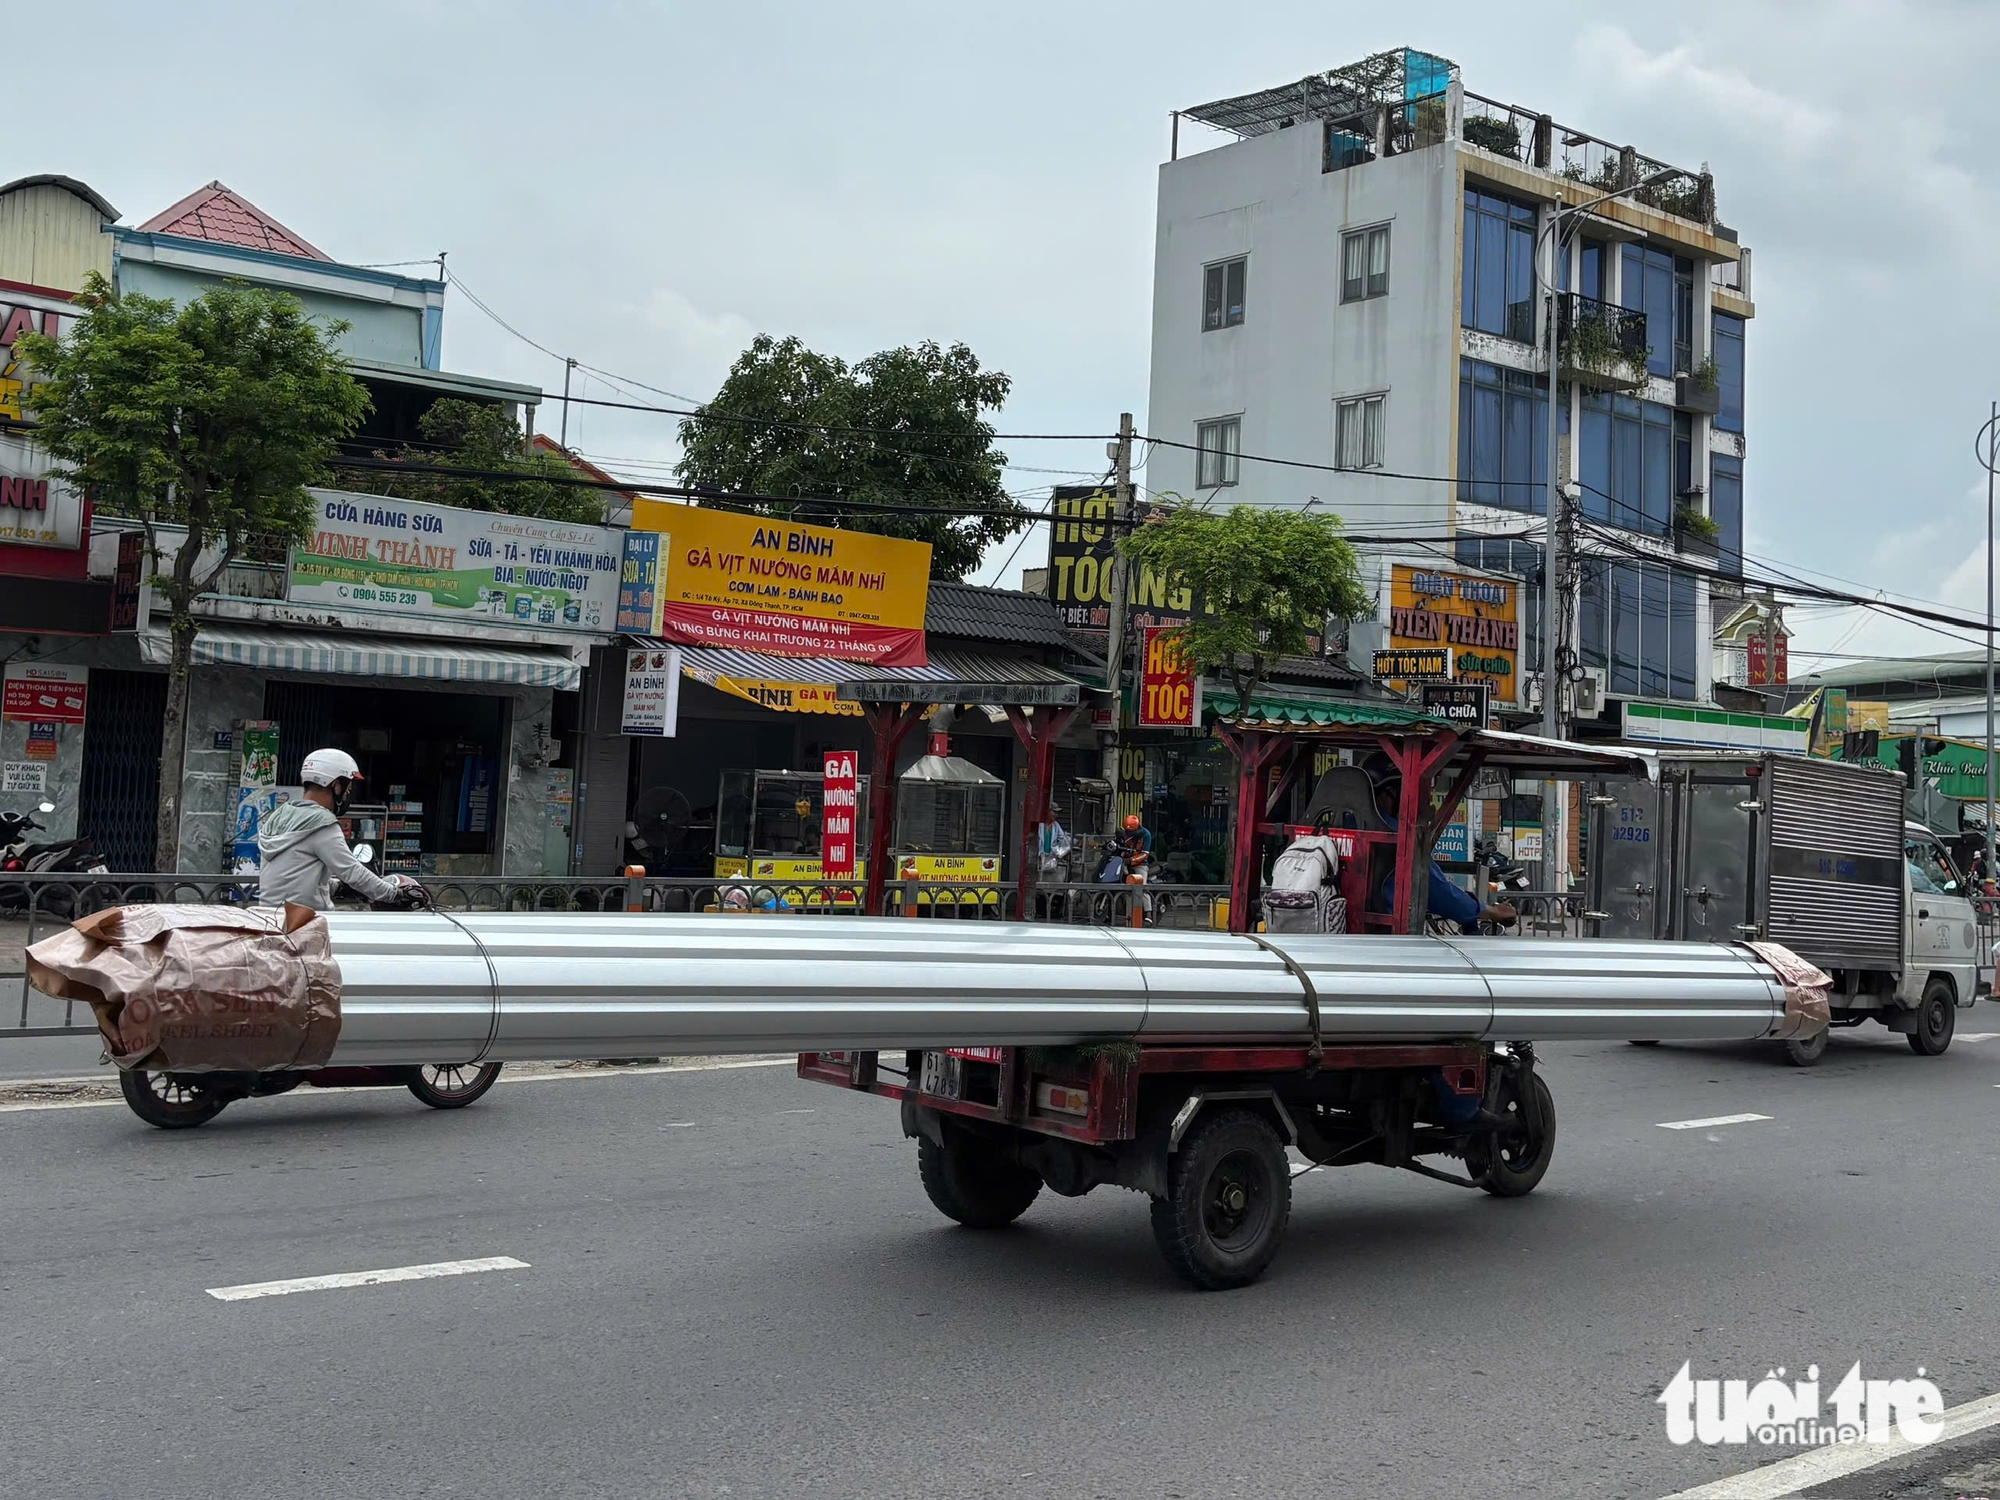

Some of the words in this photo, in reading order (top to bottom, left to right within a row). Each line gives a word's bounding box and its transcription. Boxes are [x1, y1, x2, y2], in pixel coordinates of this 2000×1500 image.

[325, 499, 358, 523] CỬA
[363, 506, 407, 529] HÀNG
[412, 513, 444, 534] SỮA
[525, 525, 548, 539] Cung
[752, 527, 781, 550] AN
[787, 528, 834, 557] BÌNH
[304, 530, 370, 562] MINH
[375, 536, 457, 570] THÀNH
[468, 538, 493, 558] SỮA
[504, 541, 518, 561] TÃ
[530, 544, 552, 565] YẾN
[554, 549, 593, 570] KHÁNH
[595, 551, 617, 572] HÒA
[687, 546, 712, 569] GÀ
[718, 553, 745, 575] VỊT
[749, 557, 812, 581] NƯỚNG
[494, 566, 514, 584] BIA
[525, 568, 557, 588] NƯỚC
[559, 572, 590, 594] NGỌT
[353, 589, 376, 600] 0904
[379, 591, 397, 602] 555
[399, 593, 417, 605] 239
[729, 580, 755, 593] CƠM
[757, 583, 780, 597] LAM
[789, 586, 818, 602] BÁNH
[821, 592, 844, 605] BAO
[1459, 579, 1507, 610] THOẠI
[712, 608, 730, 622] GÀ
[732, 611, 752, 626] VỊT
[754, 613, 800, 631] NƯỚNG
[1447, 605, 1519, 651] THÀNH
[743, 630, 771, 643] KHAI
[773, 632, 822, 649] TRƯƠNG
[823, 639, 837, 650] 22
[838, 638, 877, 653] THÁNG
[1376, 653, 1395, 674] HỚT
[1398, 653, 1417, 674] TÓC
[1418, 657, 1443, 674] NAM
[629, 677, 642, 689] AN
[643, 675, 665, 689] BÌNH
[799, 686, 819, 700] GÀ
[1146, 676, 1191, 721] TÓC
[825, 756, 854, 778] GÀ
[824, 786, 855, 807] NƯỚNG
[827, 812, 850, 834] MẮM
[793, 864, 805, 873] AN
[934, 859, 946, 869] AN
